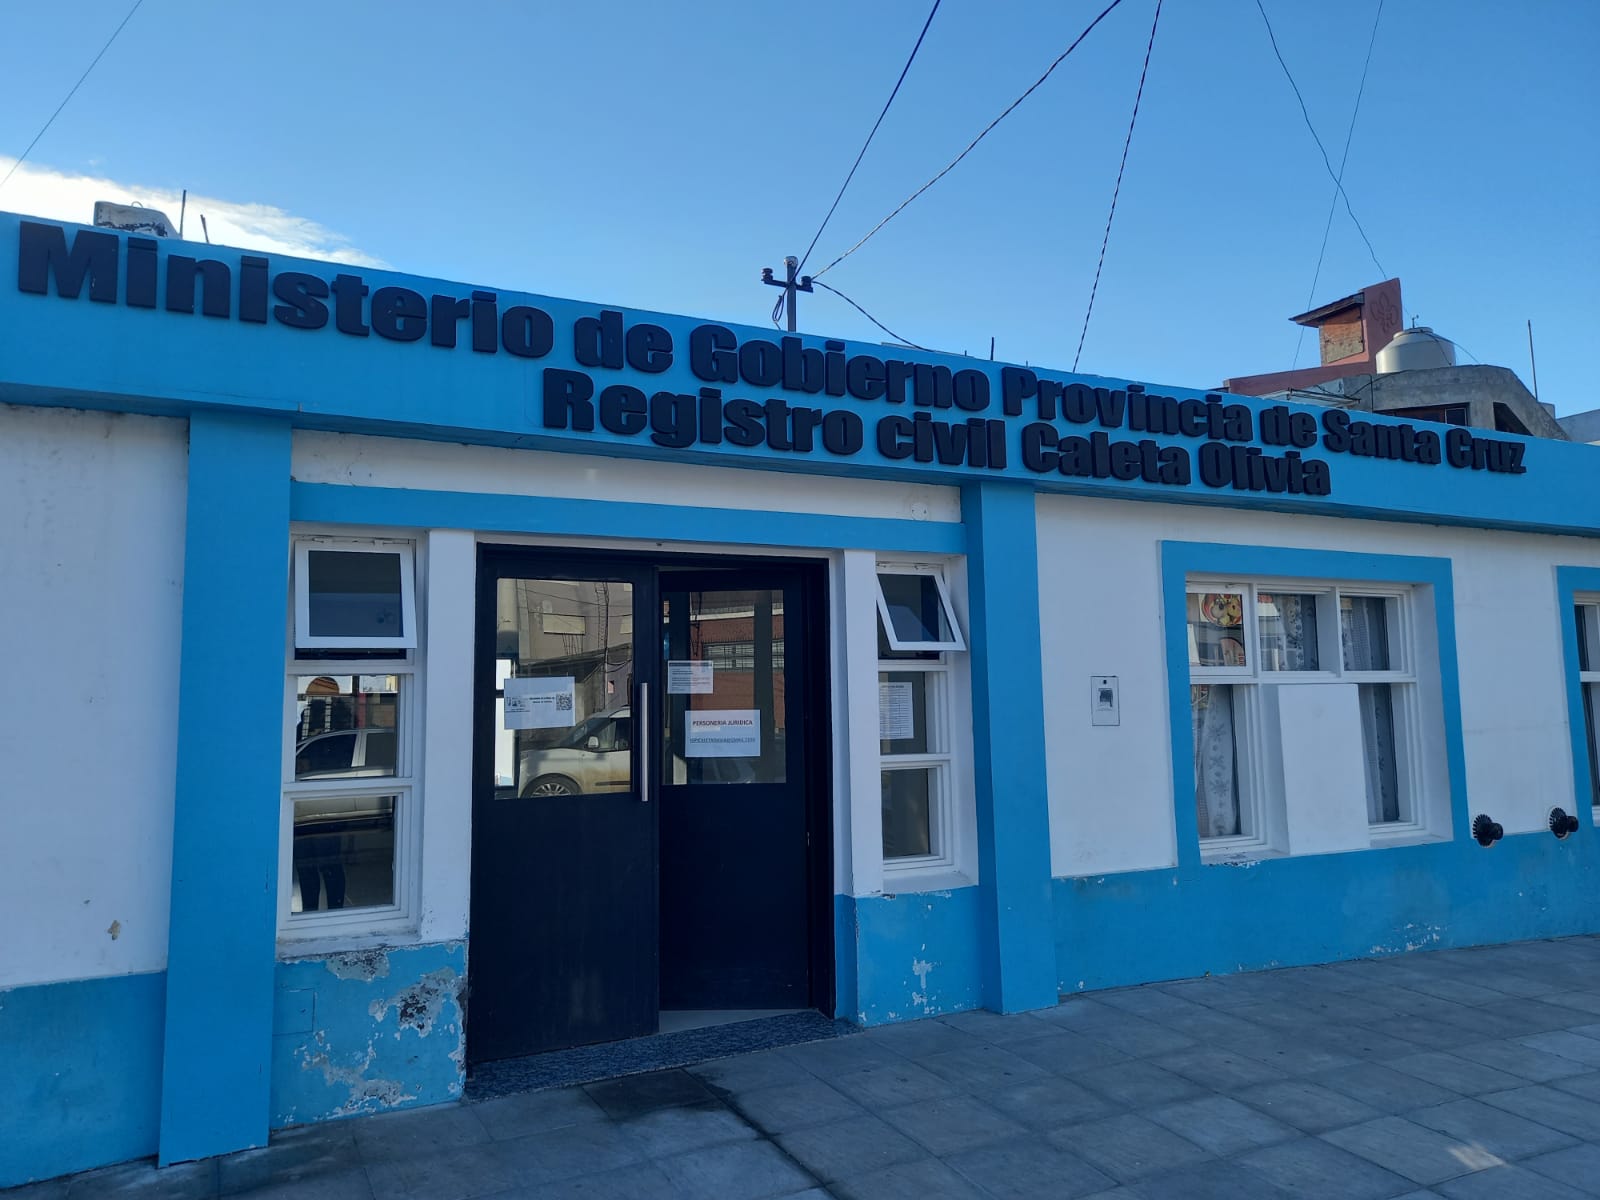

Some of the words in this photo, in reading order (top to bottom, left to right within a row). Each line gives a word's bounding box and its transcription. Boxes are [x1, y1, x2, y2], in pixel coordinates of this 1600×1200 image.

[18, 220, 554, 358] Ministerio
[574, 311, 673, 373] de
[690, 324, 991, 412] Gobierno
[1001, 367, 1253, 442] Provincia
[1260, 404, 1318, 447] de
[1322, 409, 1443, 464] Santa
[1446, 428, 1527, 474] Cruz
[543, 367, 864, 456] Registro
[876, 412, 1007, 470] civil
[1021, 422, 1192, 485] Caleta
[1200, 441, 1332, 496] Olivia
